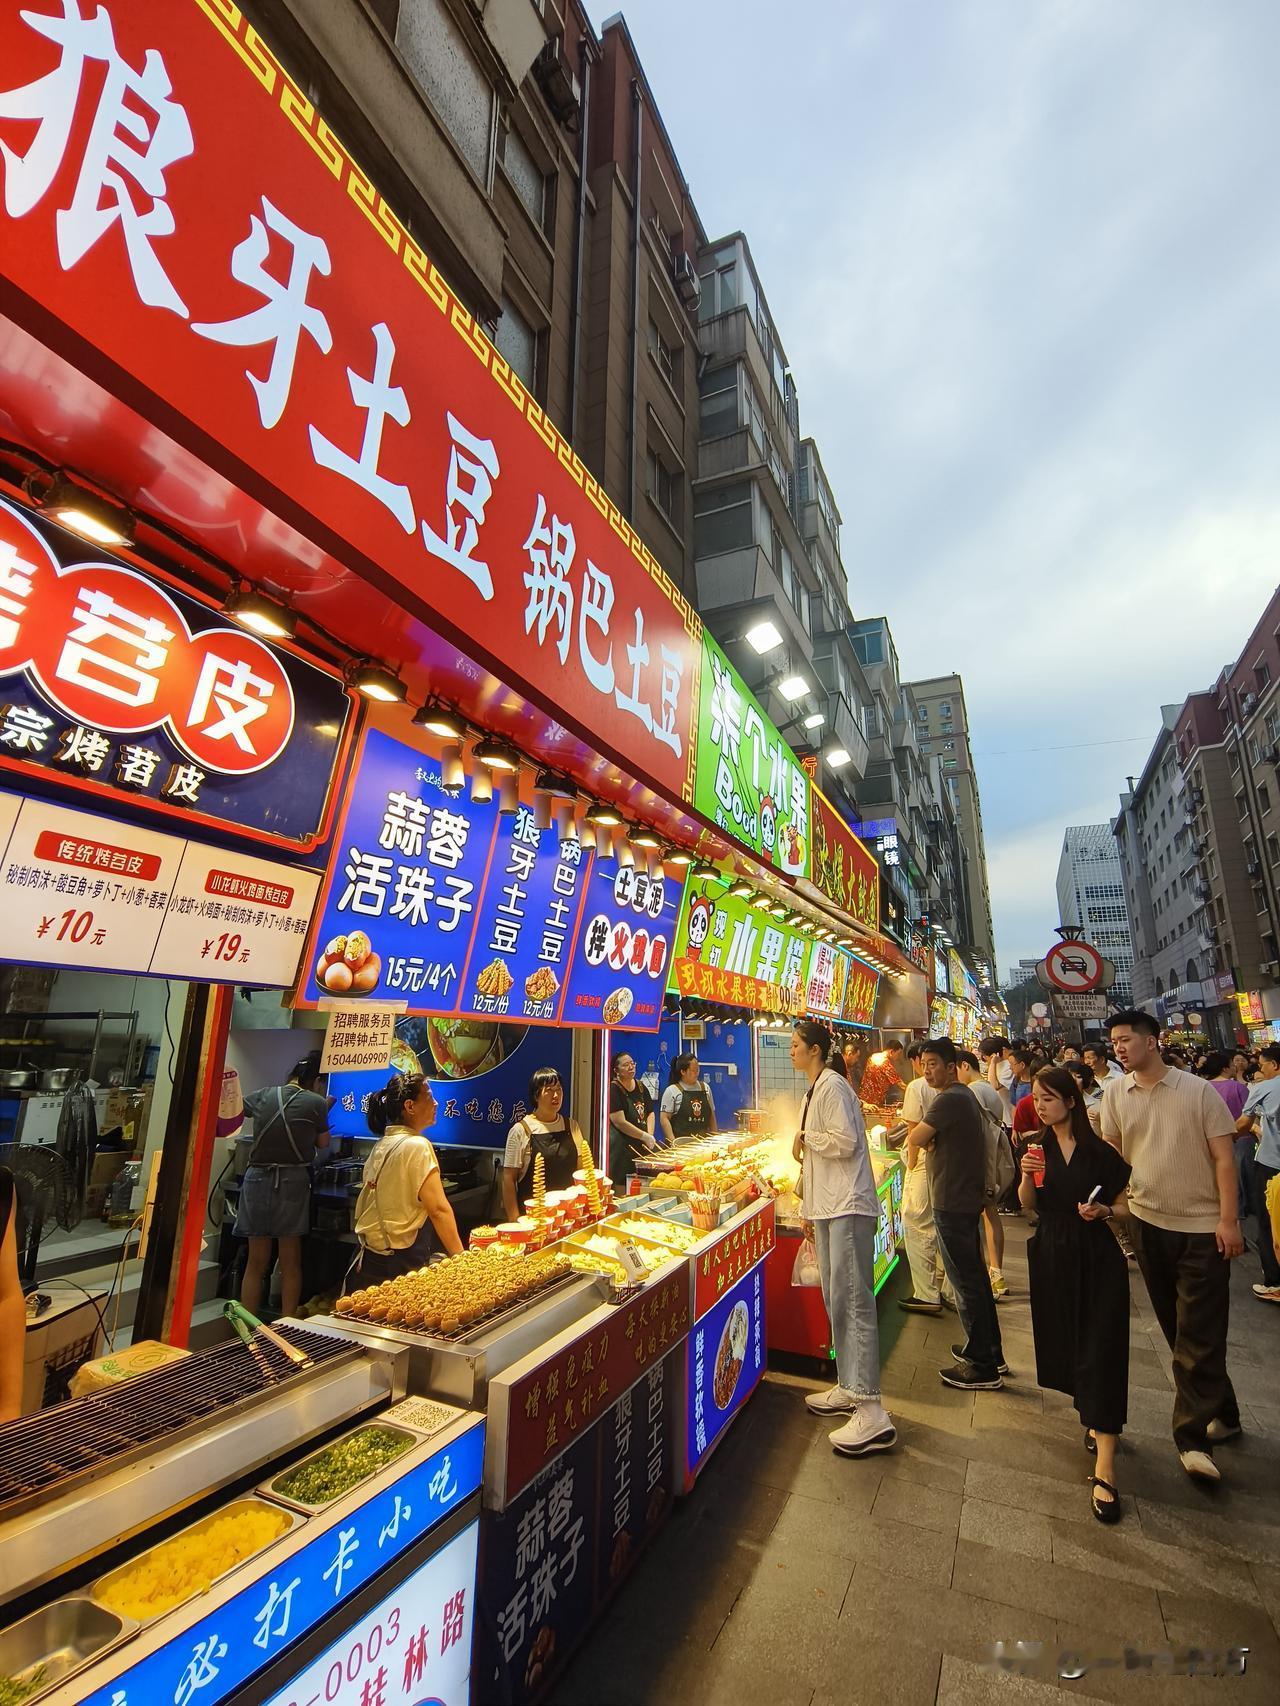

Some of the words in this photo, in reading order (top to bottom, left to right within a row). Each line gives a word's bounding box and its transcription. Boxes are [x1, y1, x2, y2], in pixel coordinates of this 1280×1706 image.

[0, 0, 500, 600] 狼牙土豆
[522, 494, 685, 759] 锅巴土豆
[57, 839, 144, 875] 传统烤苕皮
[380, 791, 470, 870] 蒜蓉
[883, 835, 900, 866] 眼镜
[211, 874, 289, 906] 小龙虾火鸡面烤苕皮
[338, 847, 474, 932] 活珠子
[488, 807, 541, 954] 狼牙土豆
[616, 870, 662, 914] 土豆泥
[386, 956, 457, 997] 15元/4个
[587, 919, 665, 974] 拌火鸡面
[334, 1012, 391, 1029] 招聘服务员
[471, 994, 509, 1015] 12元/份
[523, 999, 554, 1019] 12元/份
[327, 1052, 388, 1066] 15044069909
[330, 1032, 389, 1048] 招聘钟点工
[525, 1330, 609, 1419] 增强免疫力
[543, 1375, 609, 1456] 益气补血
[515, 1468, 575, 1580] 蒜蓉
[111, 1455, 459, 1706] 必打卡小吃
[494, 1516, 584, 1680] 活珠子
[284, 1607, 401, 1706] -0003
